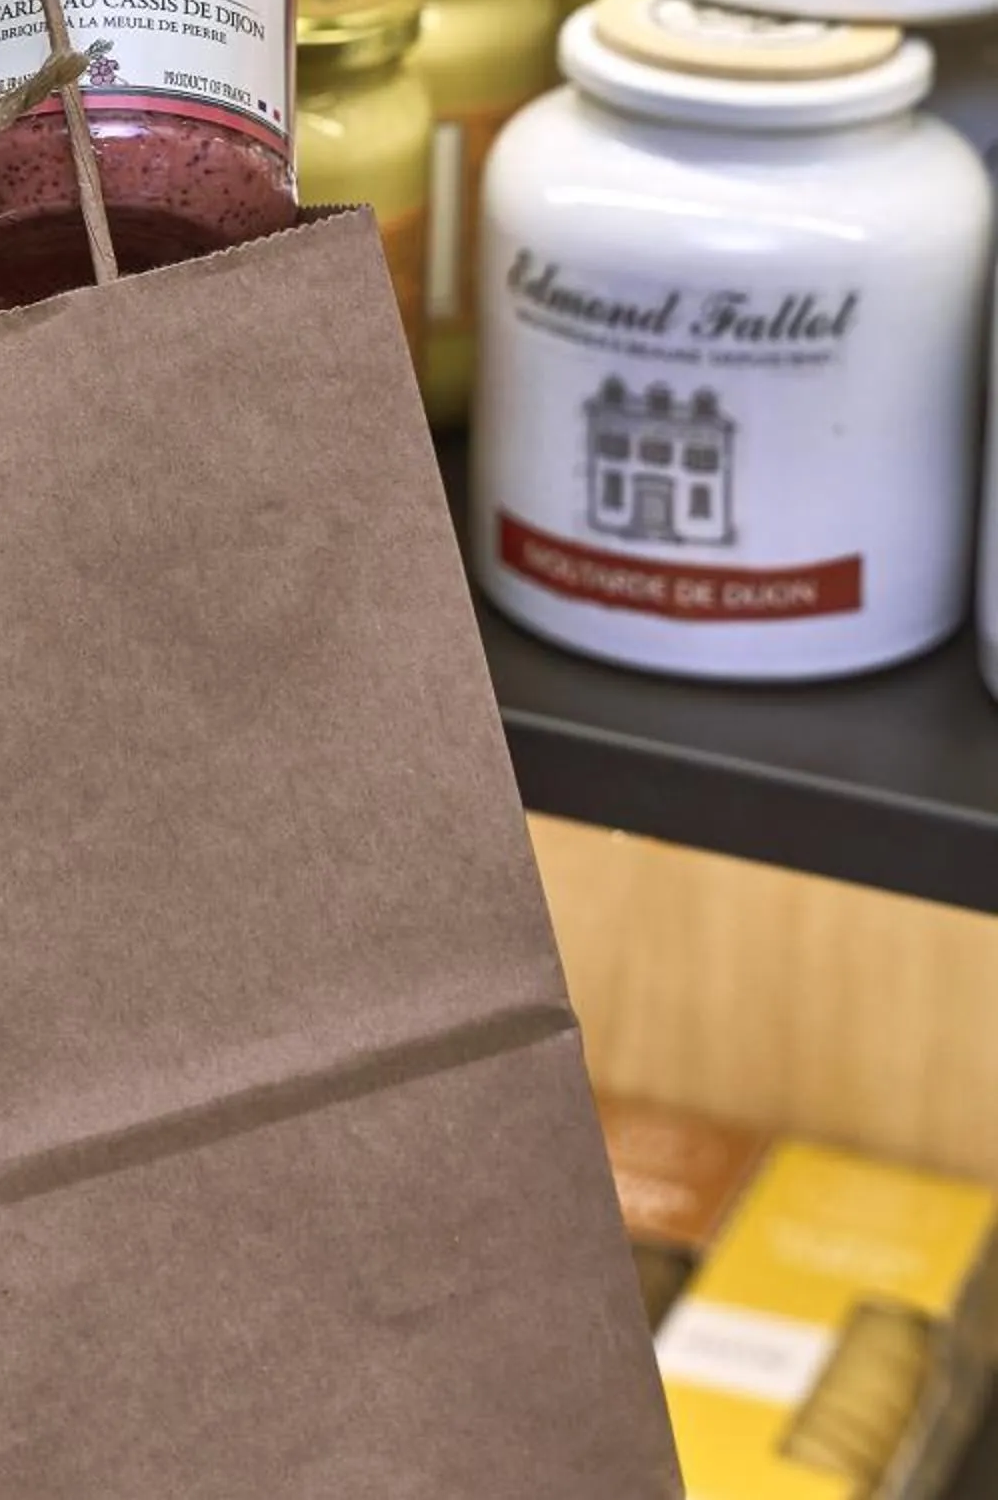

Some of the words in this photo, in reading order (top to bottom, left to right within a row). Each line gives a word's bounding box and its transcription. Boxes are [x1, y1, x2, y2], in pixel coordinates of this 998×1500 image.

[79, 16, 99, 29] LA
[103, 16, 155, 31] MEULE
[159, 19, 179, 33] DE
[182, 23, 227, 45] PIERRE
[215, 4, 266, 42] DIJON
